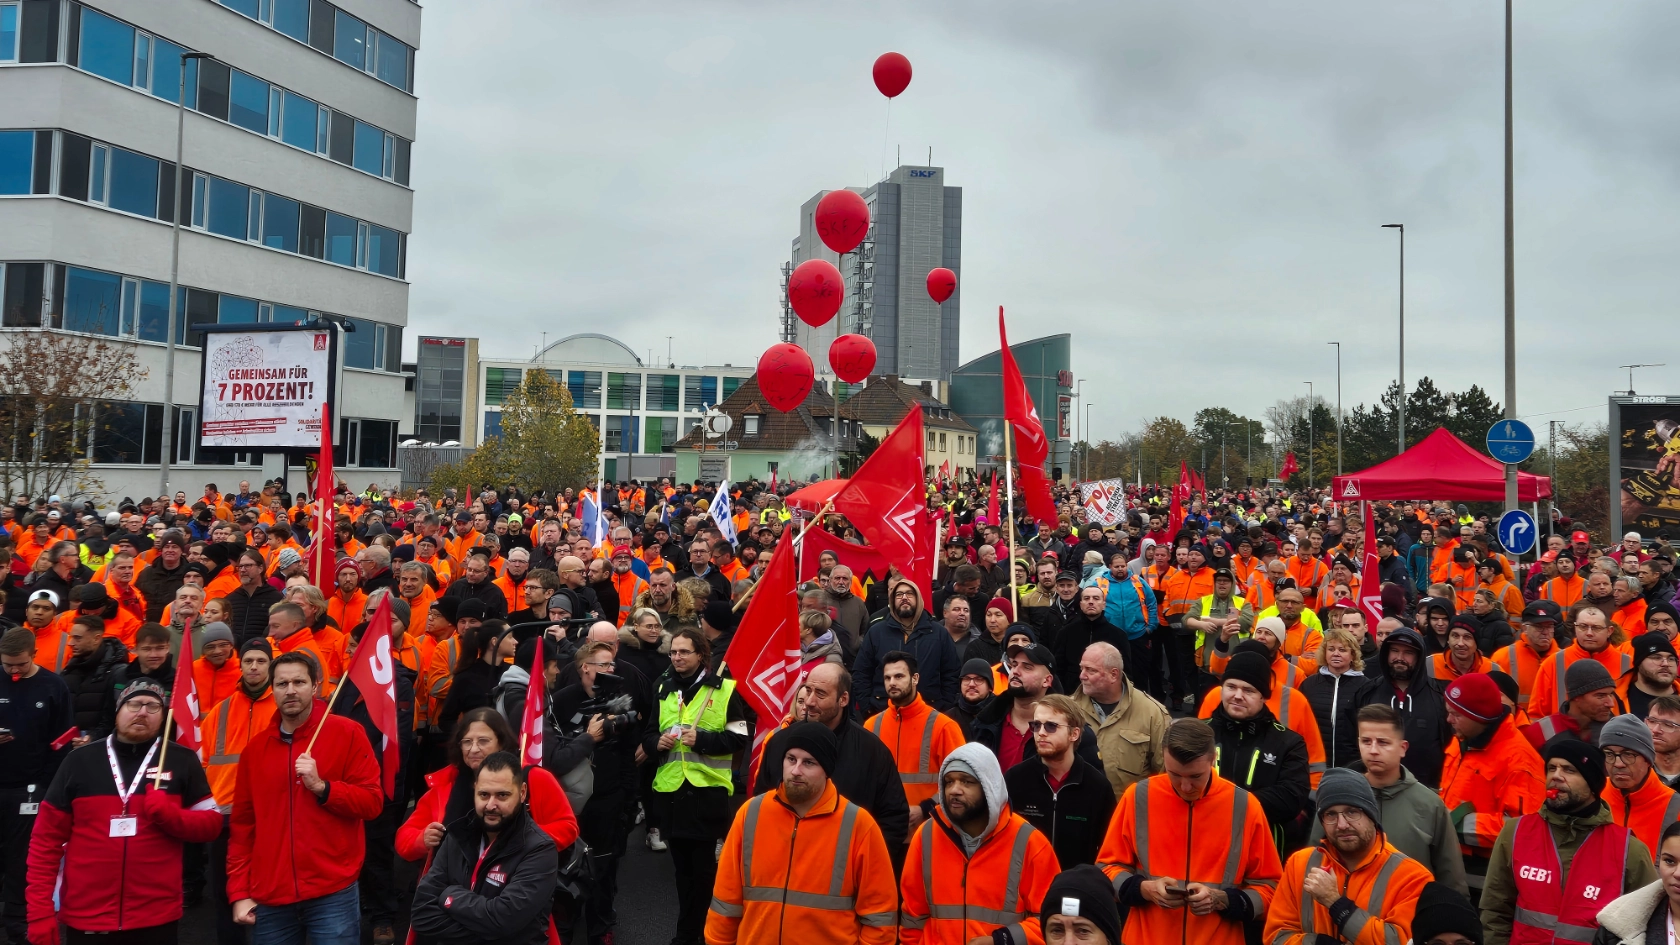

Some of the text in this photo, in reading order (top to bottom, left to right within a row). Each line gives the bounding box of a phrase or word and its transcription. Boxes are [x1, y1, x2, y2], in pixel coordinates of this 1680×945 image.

[910, 169, 937, 178] SKF
[228, 365, 308, 381] GEMEINSAM FÜR
[218, 381, 314, 401] 7 PROZENT!
[298, 417, 322, 425] SOLIDARITÄ
